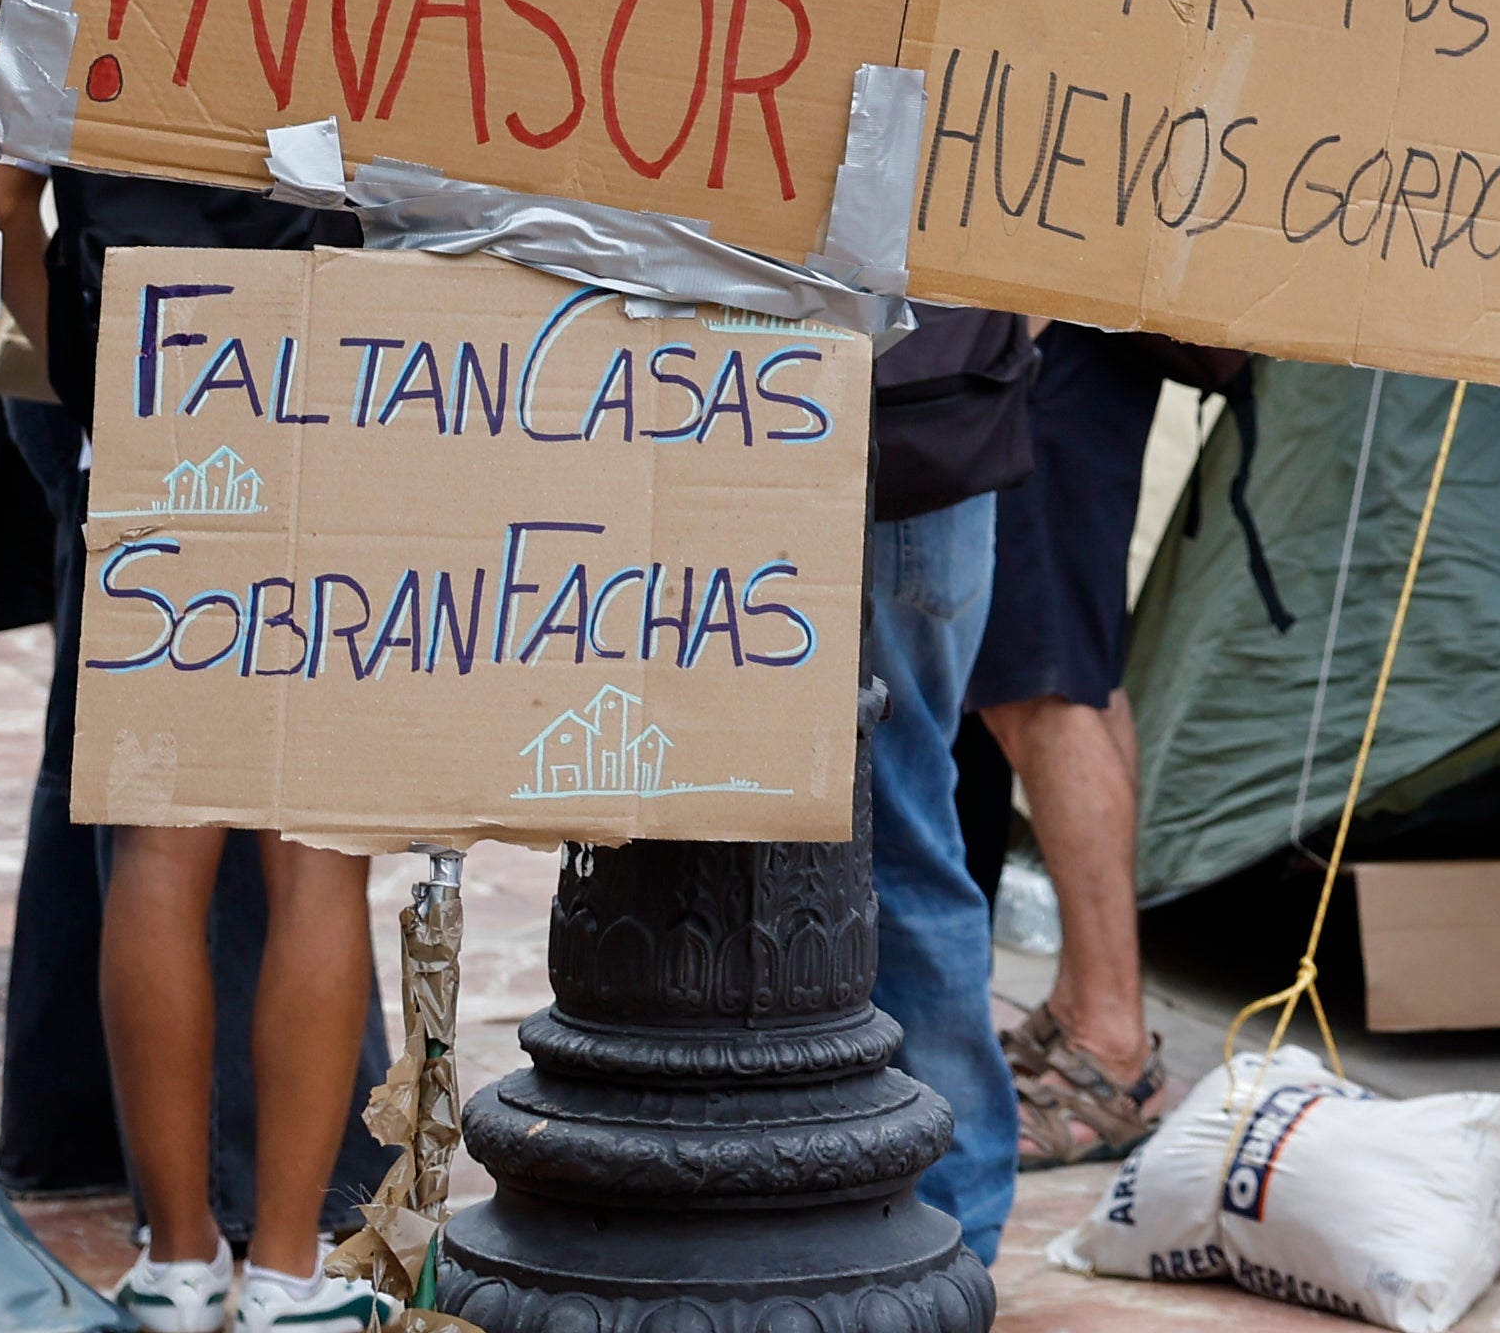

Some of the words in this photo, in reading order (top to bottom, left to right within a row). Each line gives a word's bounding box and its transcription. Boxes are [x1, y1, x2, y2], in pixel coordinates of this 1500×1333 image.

[917, 48, 1259, 240] HUEVOS
[133, 283, 511, 437] FALTAN
[517, 285, 833, 446] CASAS
[85, 536, 486, 681] SOBRAN
[493, 520, 819, 670] FACHAS
